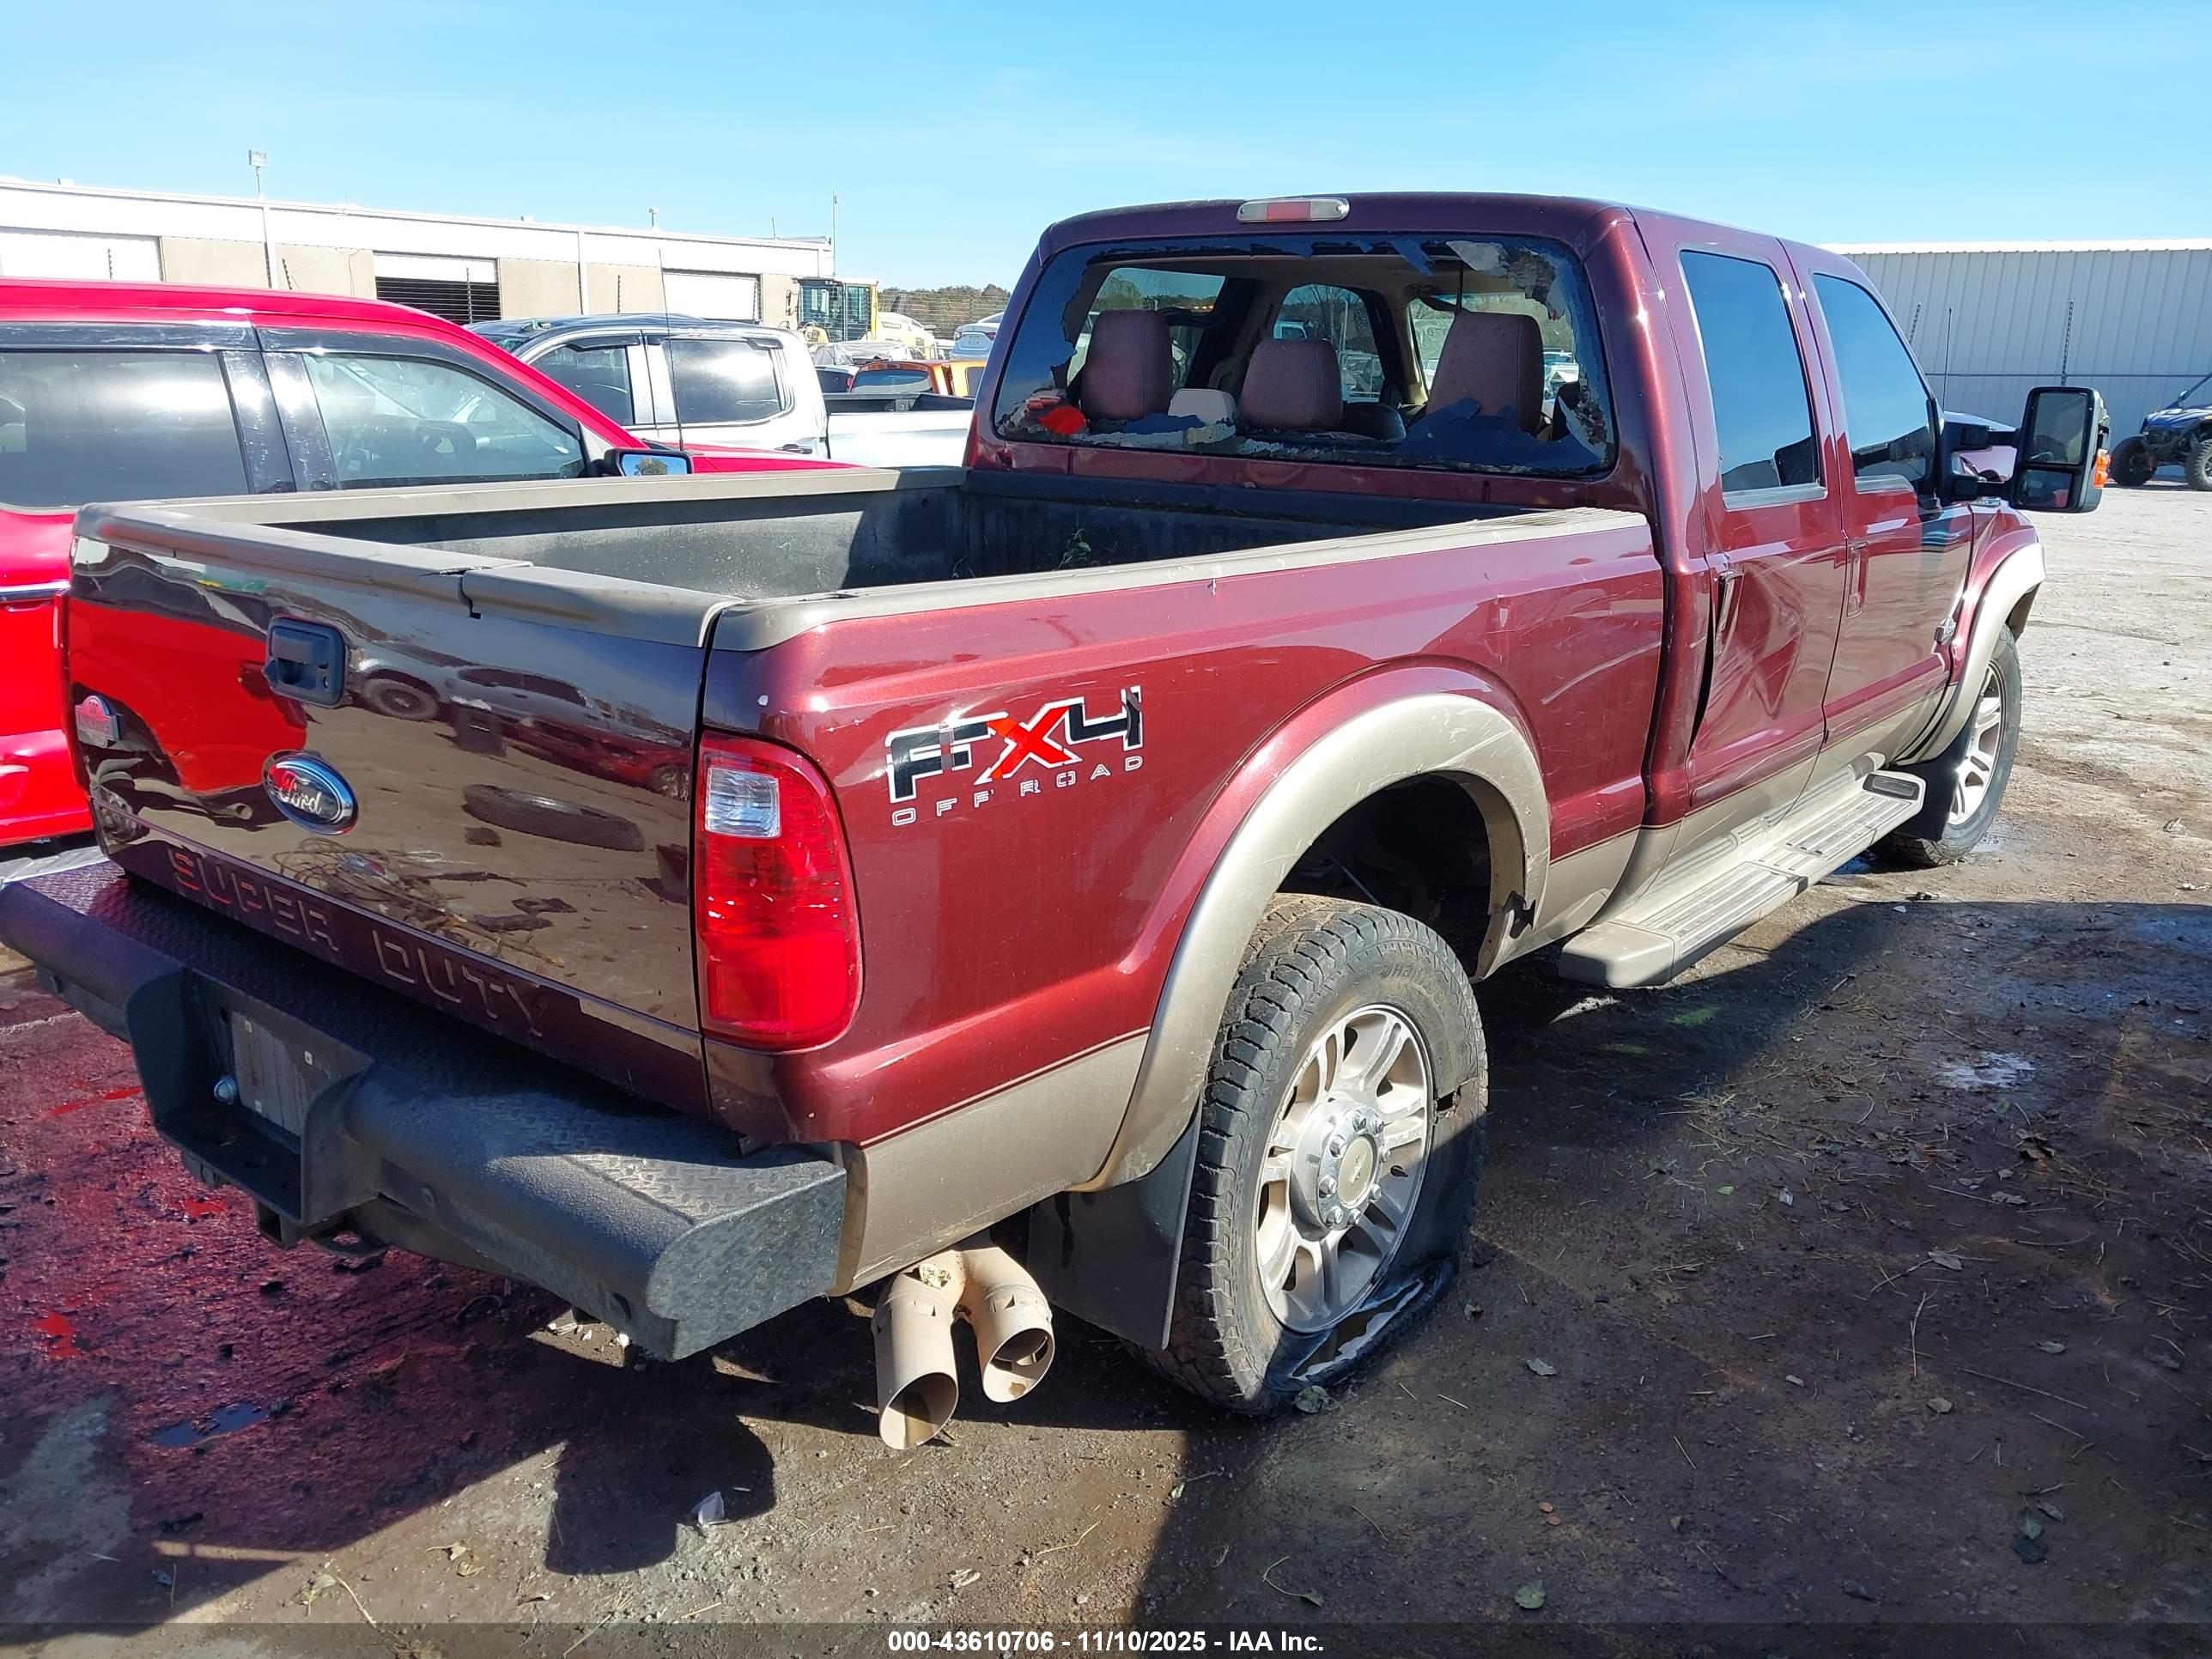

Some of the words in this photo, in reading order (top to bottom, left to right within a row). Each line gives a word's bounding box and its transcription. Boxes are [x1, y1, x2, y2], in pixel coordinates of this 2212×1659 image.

[886, 685, 1144, 804] FX4
[891, 788, 995, 827] OFF
[1019, 755, 1144, 798] ROAD
[270, 769, 324, 816] Ford
[167, 846, 340, 952] SUPER
[372, 928, 550, 1038] DUTY
